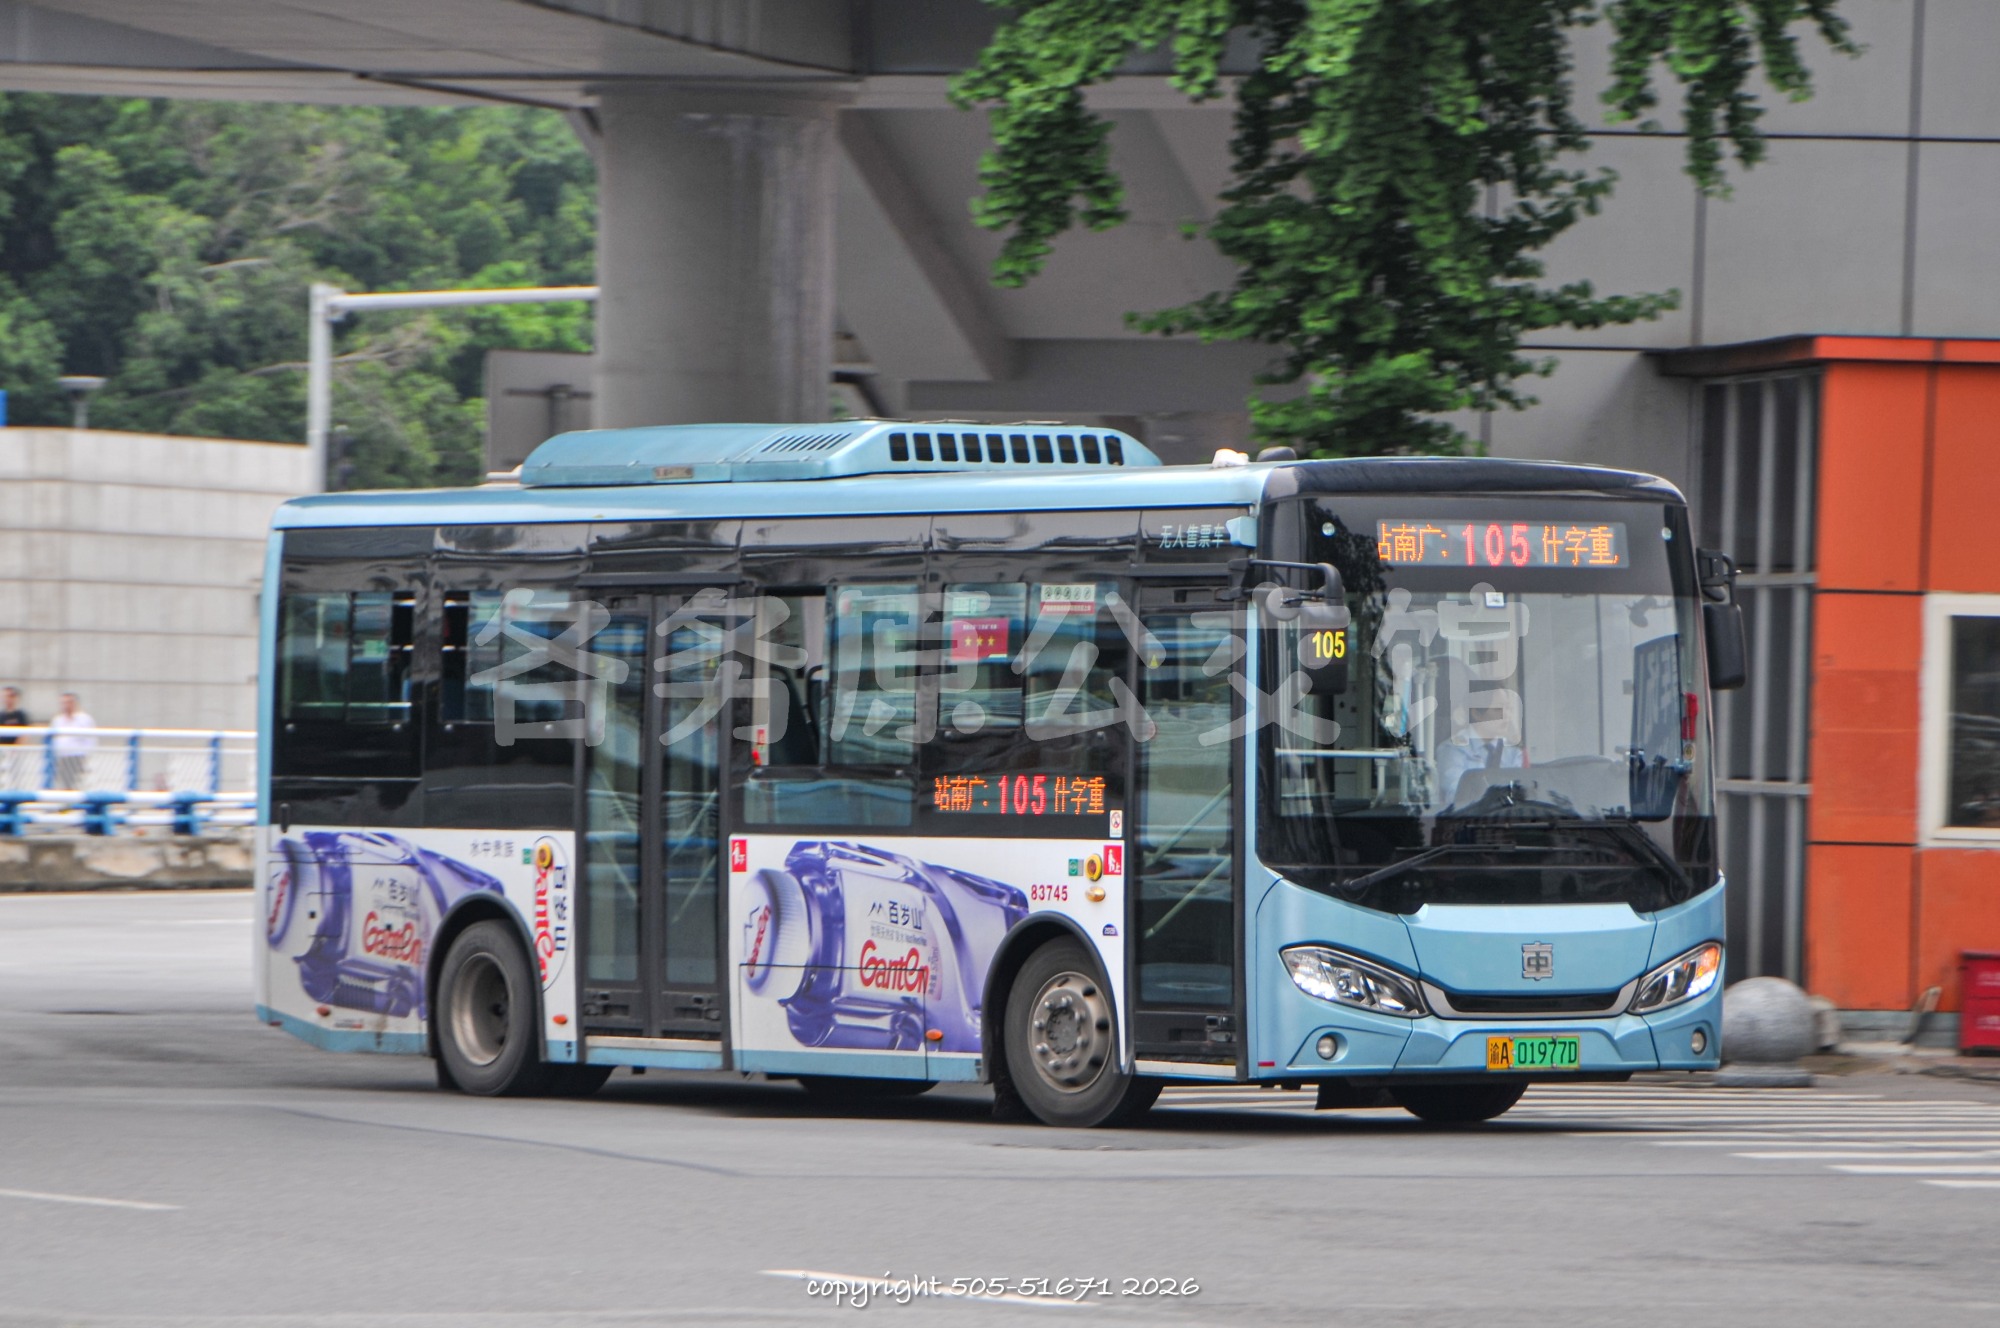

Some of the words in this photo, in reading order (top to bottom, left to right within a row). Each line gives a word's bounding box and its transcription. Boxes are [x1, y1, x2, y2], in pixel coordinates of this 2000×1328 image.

[1159, 523, 1226, 549] 无人售票车
[1462, 522, 1531, 567] 105
[1311, 630, 1346, 659] 105
[998, 774, 1047, 815] 105
[1031, 884, 1069, 901] 83745
[888, 900, 923, 931] 百岁山
